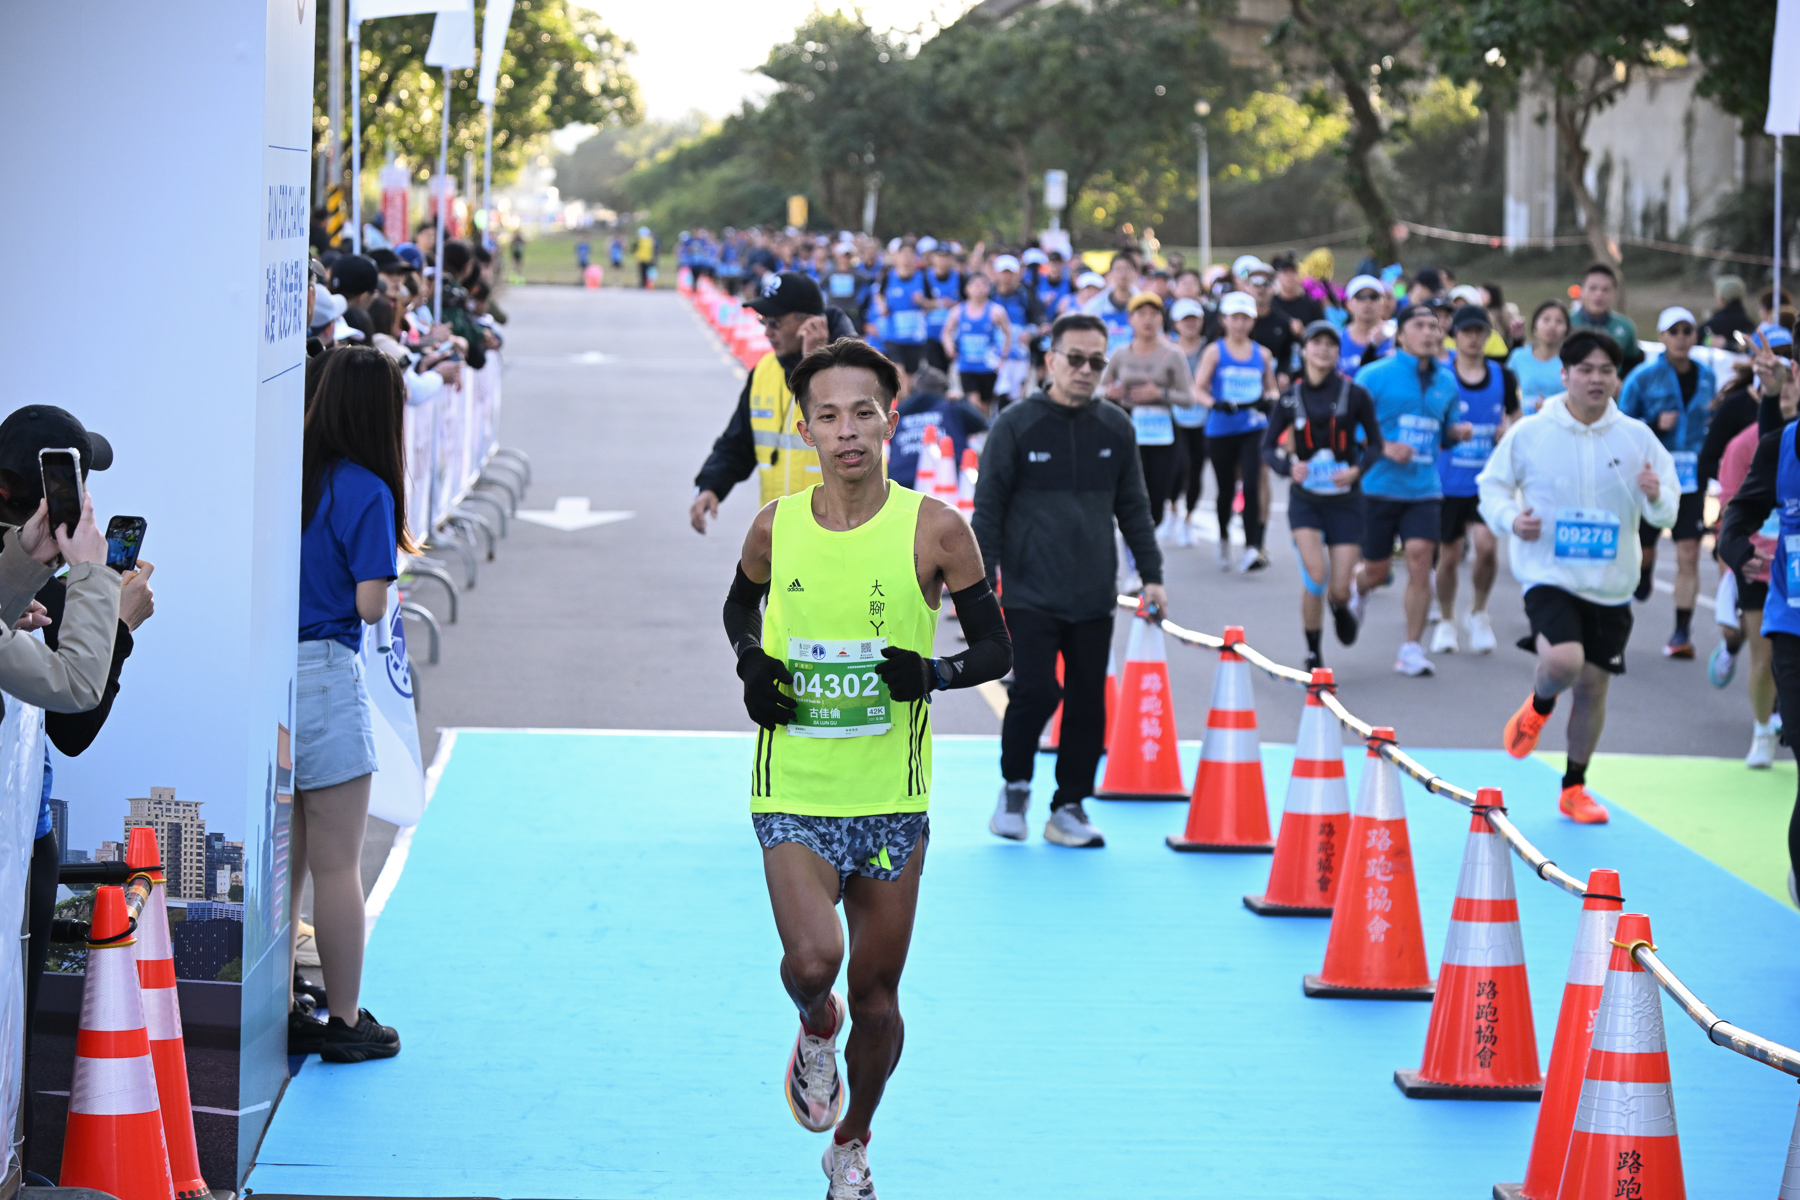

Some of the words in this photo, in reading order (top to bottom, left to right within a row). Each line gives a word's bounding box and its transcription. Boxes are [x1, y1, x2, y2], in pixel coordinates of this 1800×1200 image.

[1558, 525, 1613, 545] 09278
[793, 671, 880, 698] 04302
[809, 708, 841, 719] 古佳倫
[1139, 672, 1163, 762] 路跑協會
[1316, 821, 1337, 894] 路跑協會
[1365, 826, 1395, 943] 路跑協會
[1474, 979, 1500, 1070] 路跑協會
